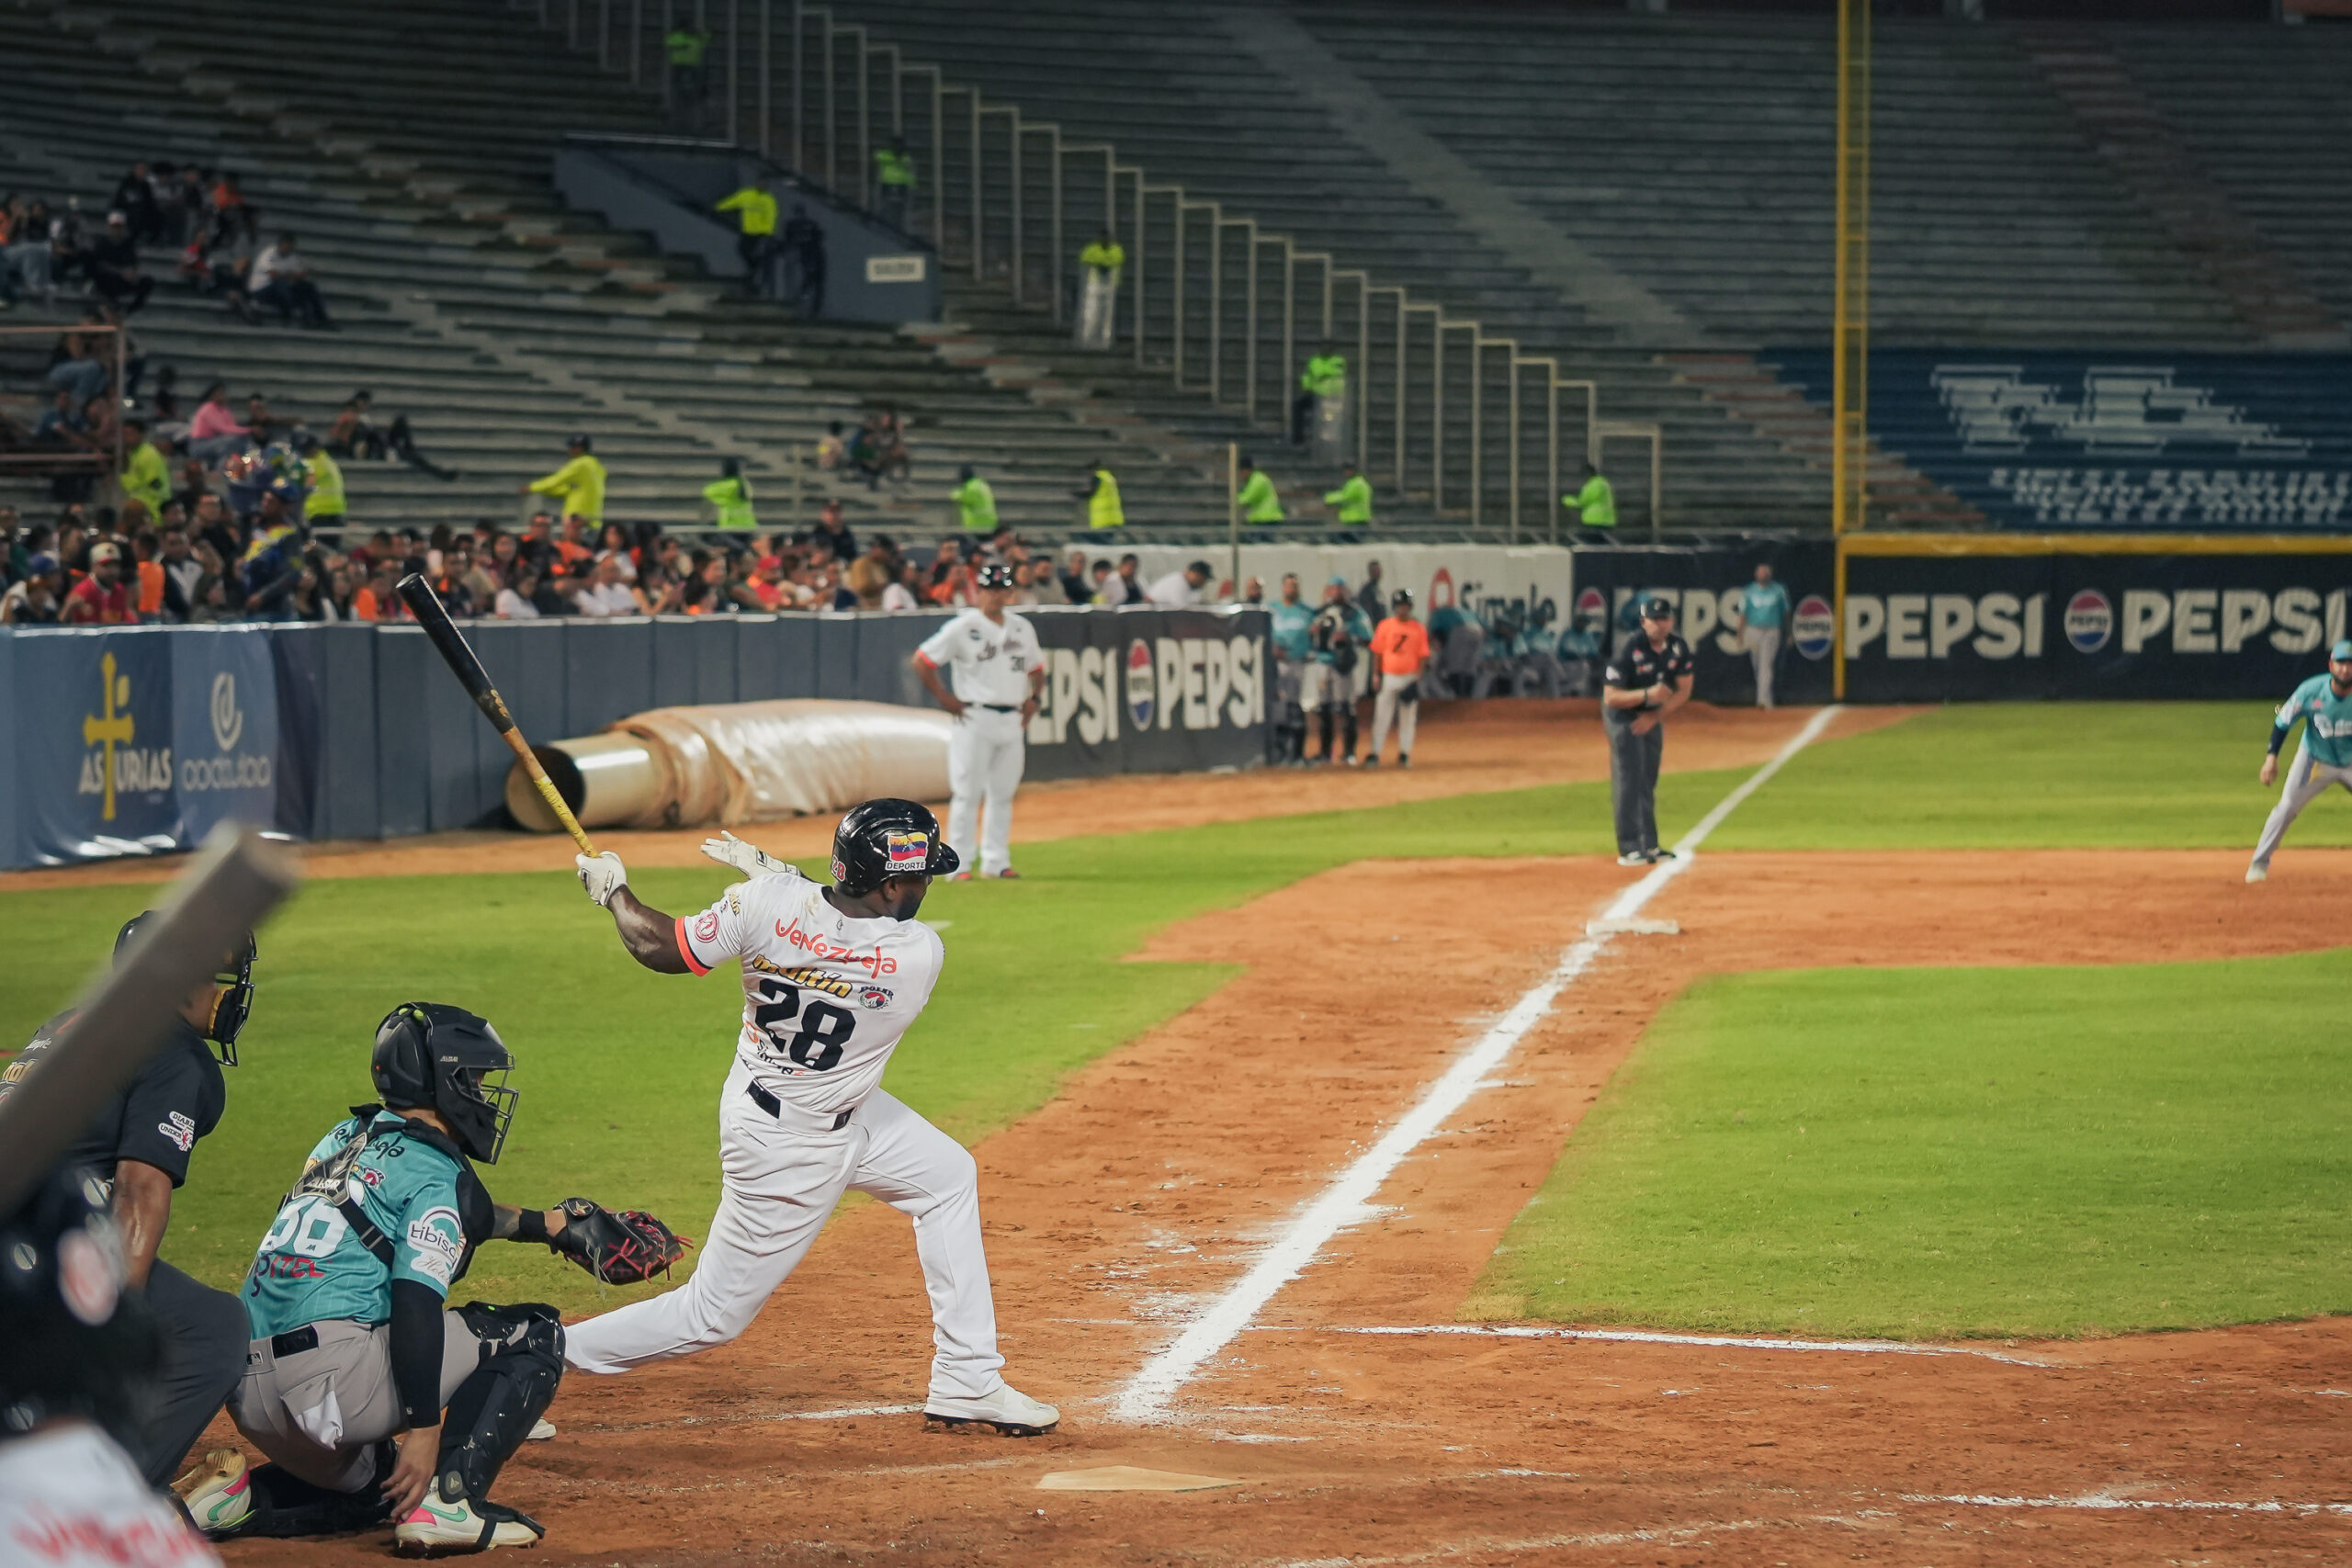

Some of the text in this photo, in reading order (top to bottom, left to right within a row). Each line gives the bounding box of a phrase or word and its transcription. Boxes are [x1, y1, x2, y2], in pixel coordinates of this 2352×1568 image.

[1844, 592, 2044, 660] PEPSI
[2121, 587, 2349, 654] PEPSI
[1027, 646, 1119, 745] EPSI
[1156, 634, 1265, 729] PEPSI
[886, 862, 926, 870] DEPORTE
[755, 978, 856, 1072] 28
[858, 986, 894, 1001] POLAR
